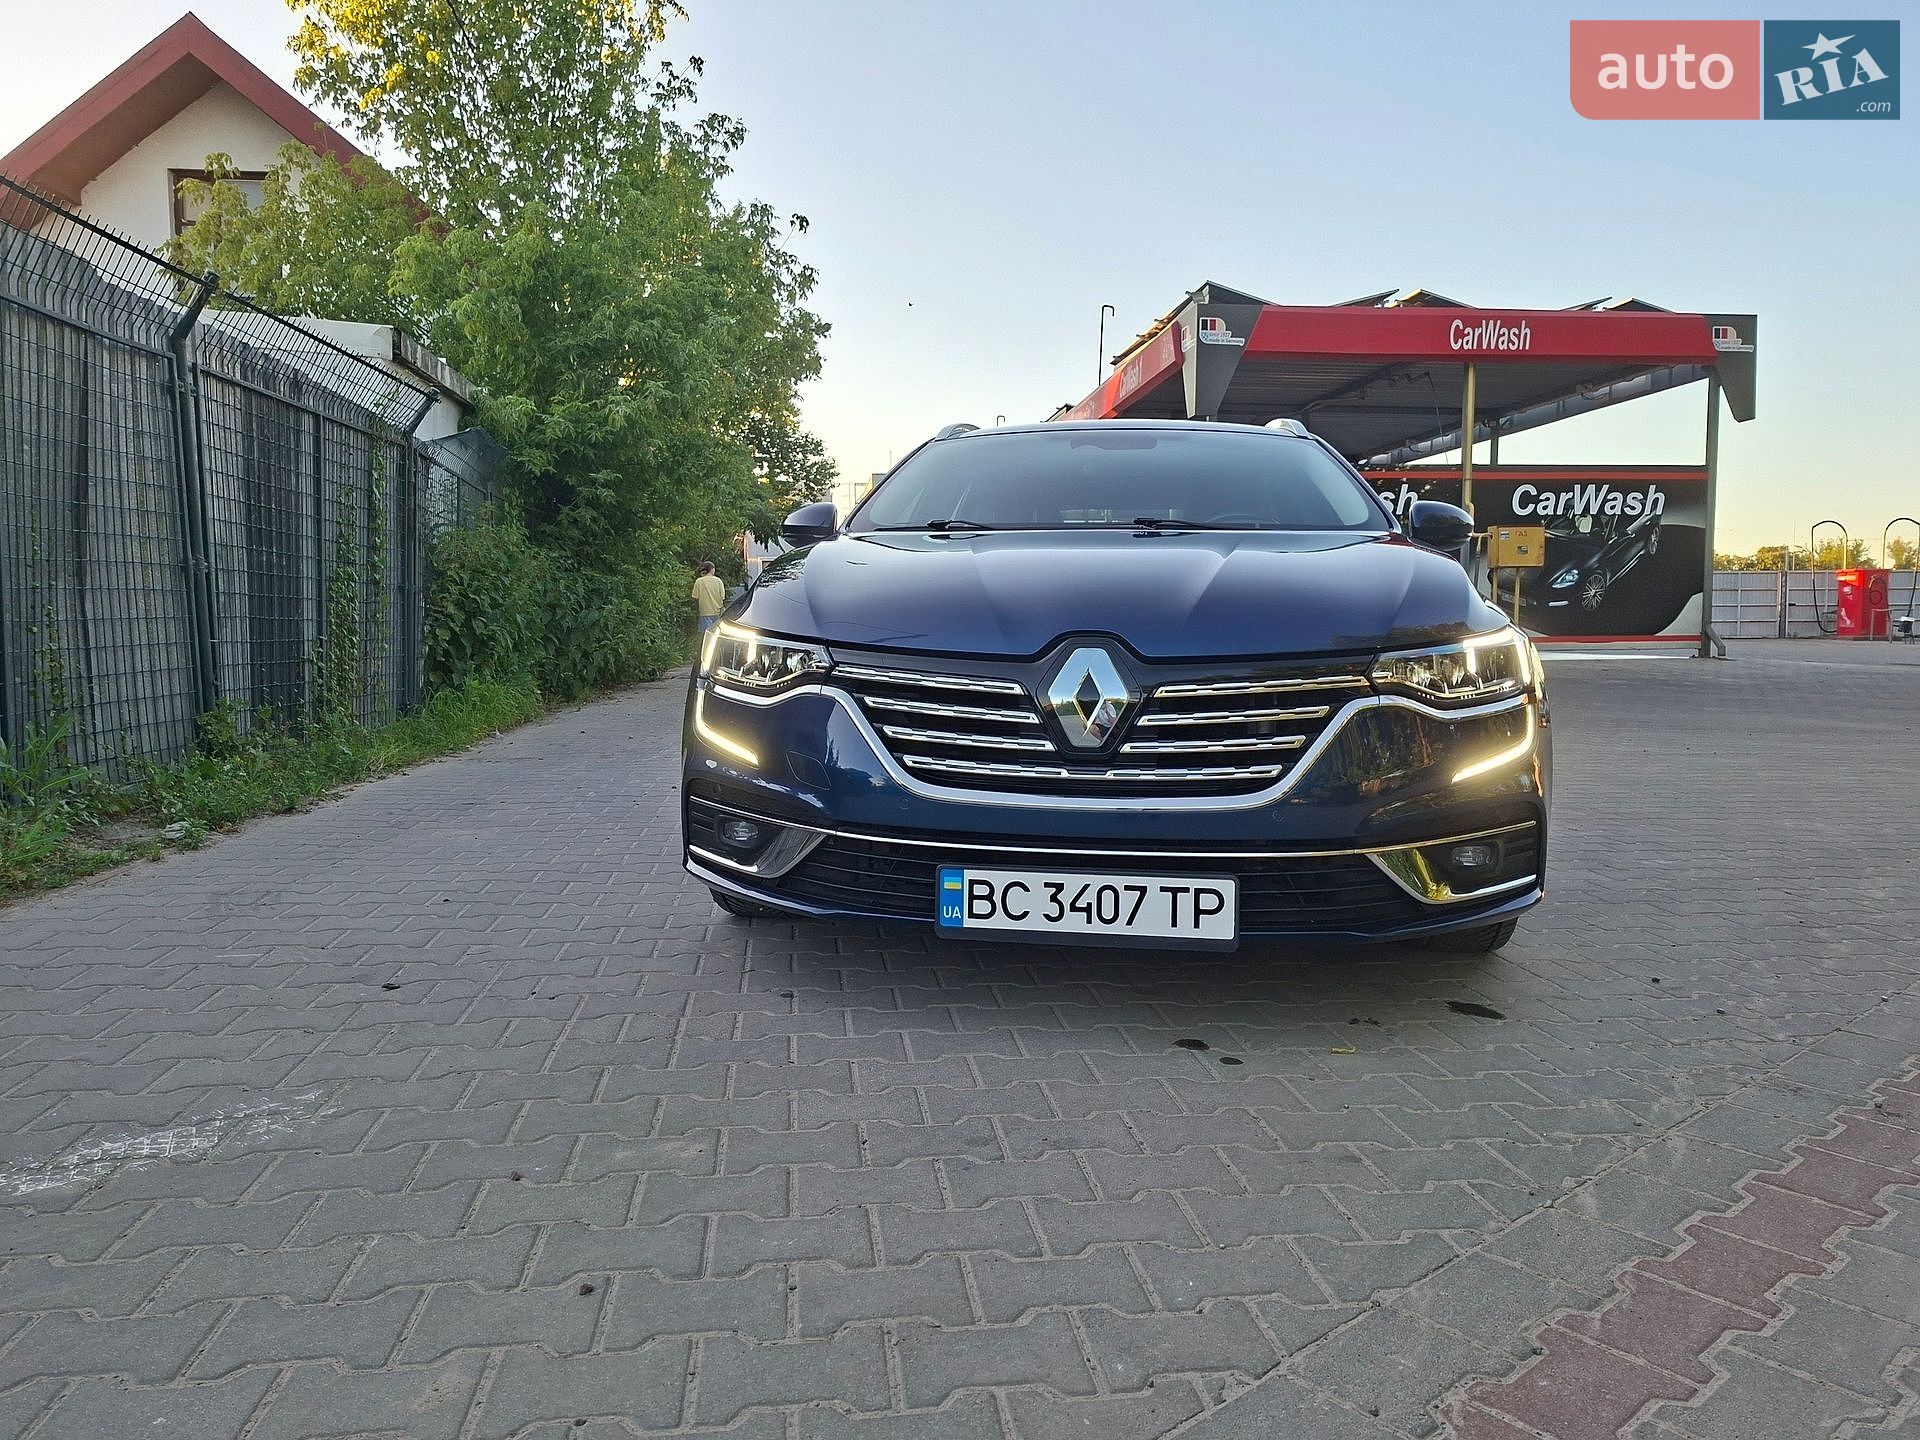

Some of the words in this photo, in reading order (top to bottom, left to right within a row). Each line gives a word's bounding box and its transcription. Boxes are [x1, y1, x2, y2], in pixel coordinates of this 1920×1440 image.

[1449, 319, 1531, 351] CarWash
[1511, 484, 1666, 516] CarWash
[943, 904, 961, 919] UA
[967, 878, 1031, 921] BC
[1042, 881, 1149, 926] 3407
[1159, 885, 1225, 929] TP
